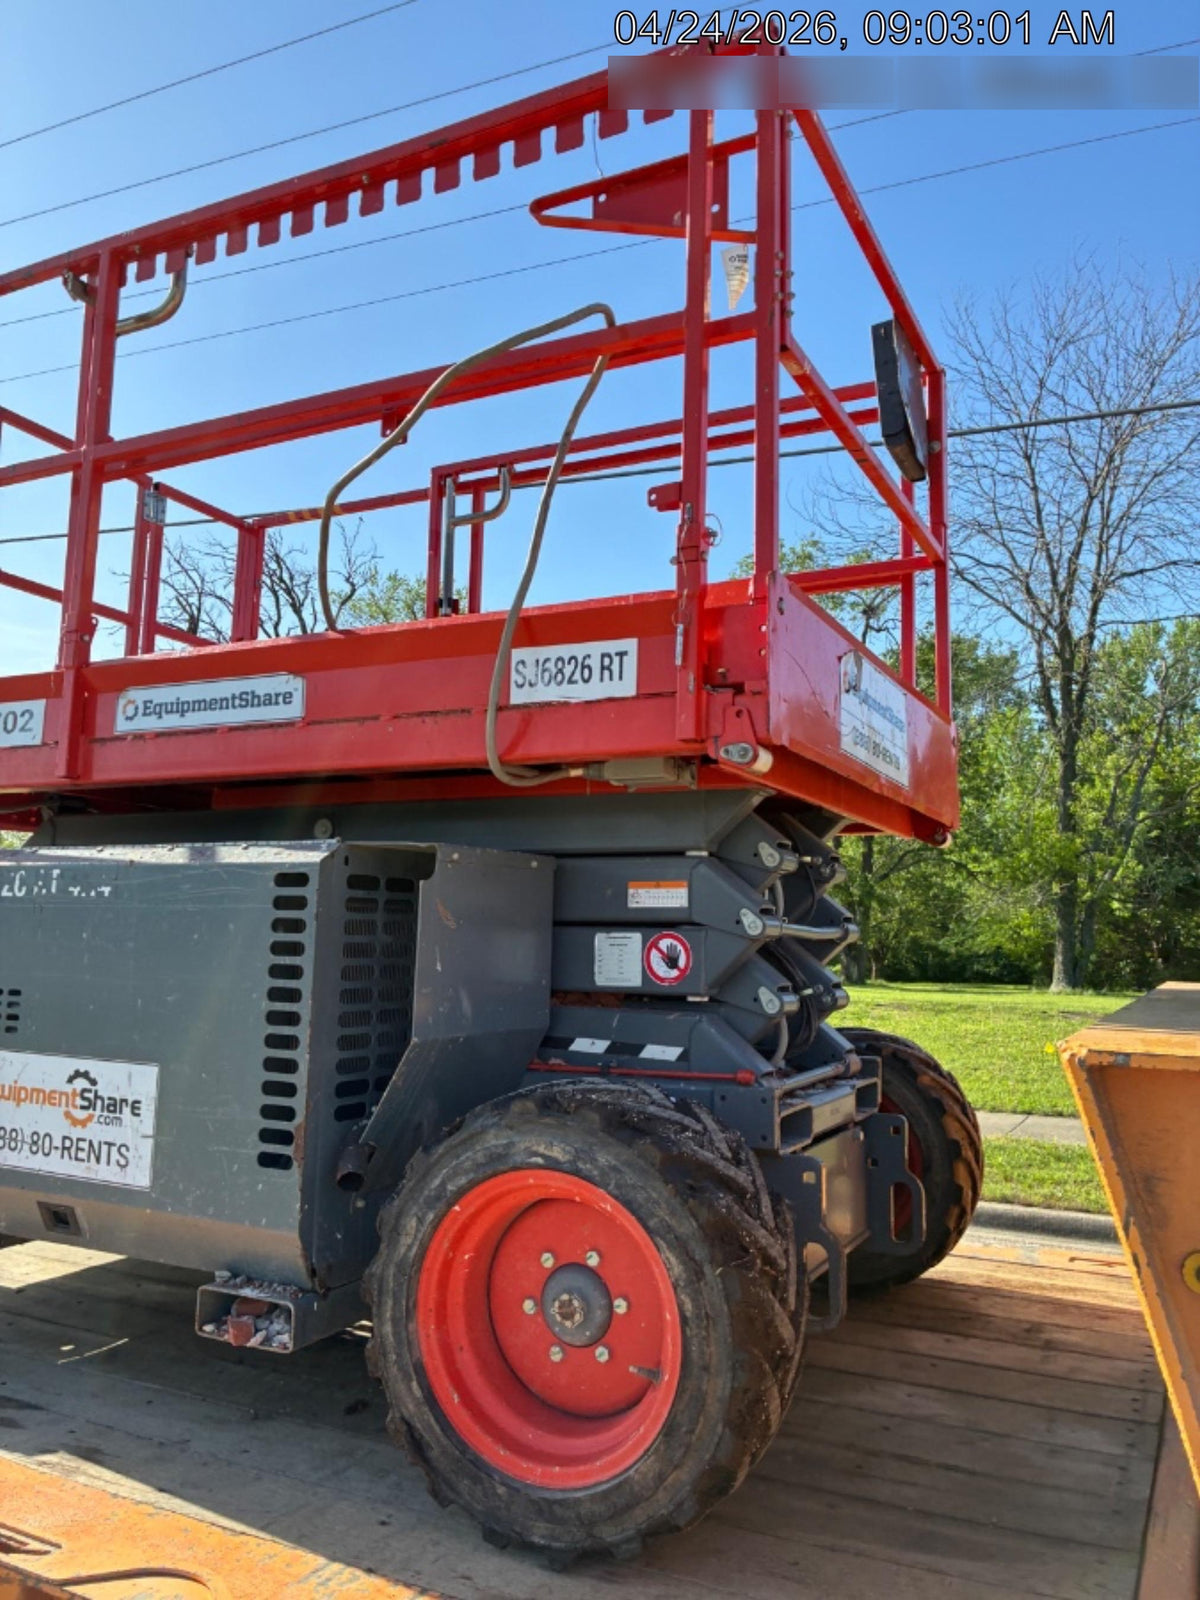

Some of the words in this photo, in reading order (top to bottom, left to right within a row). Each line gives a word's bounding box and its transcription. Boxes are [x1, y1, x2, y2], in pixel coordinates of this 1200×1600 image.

[600, 650, 628, 683] RT
[141, 690, 294, 718] EquipmentShare
[0, 708, 34, 735] 02
[94, 1113, 123, 1128] .com
